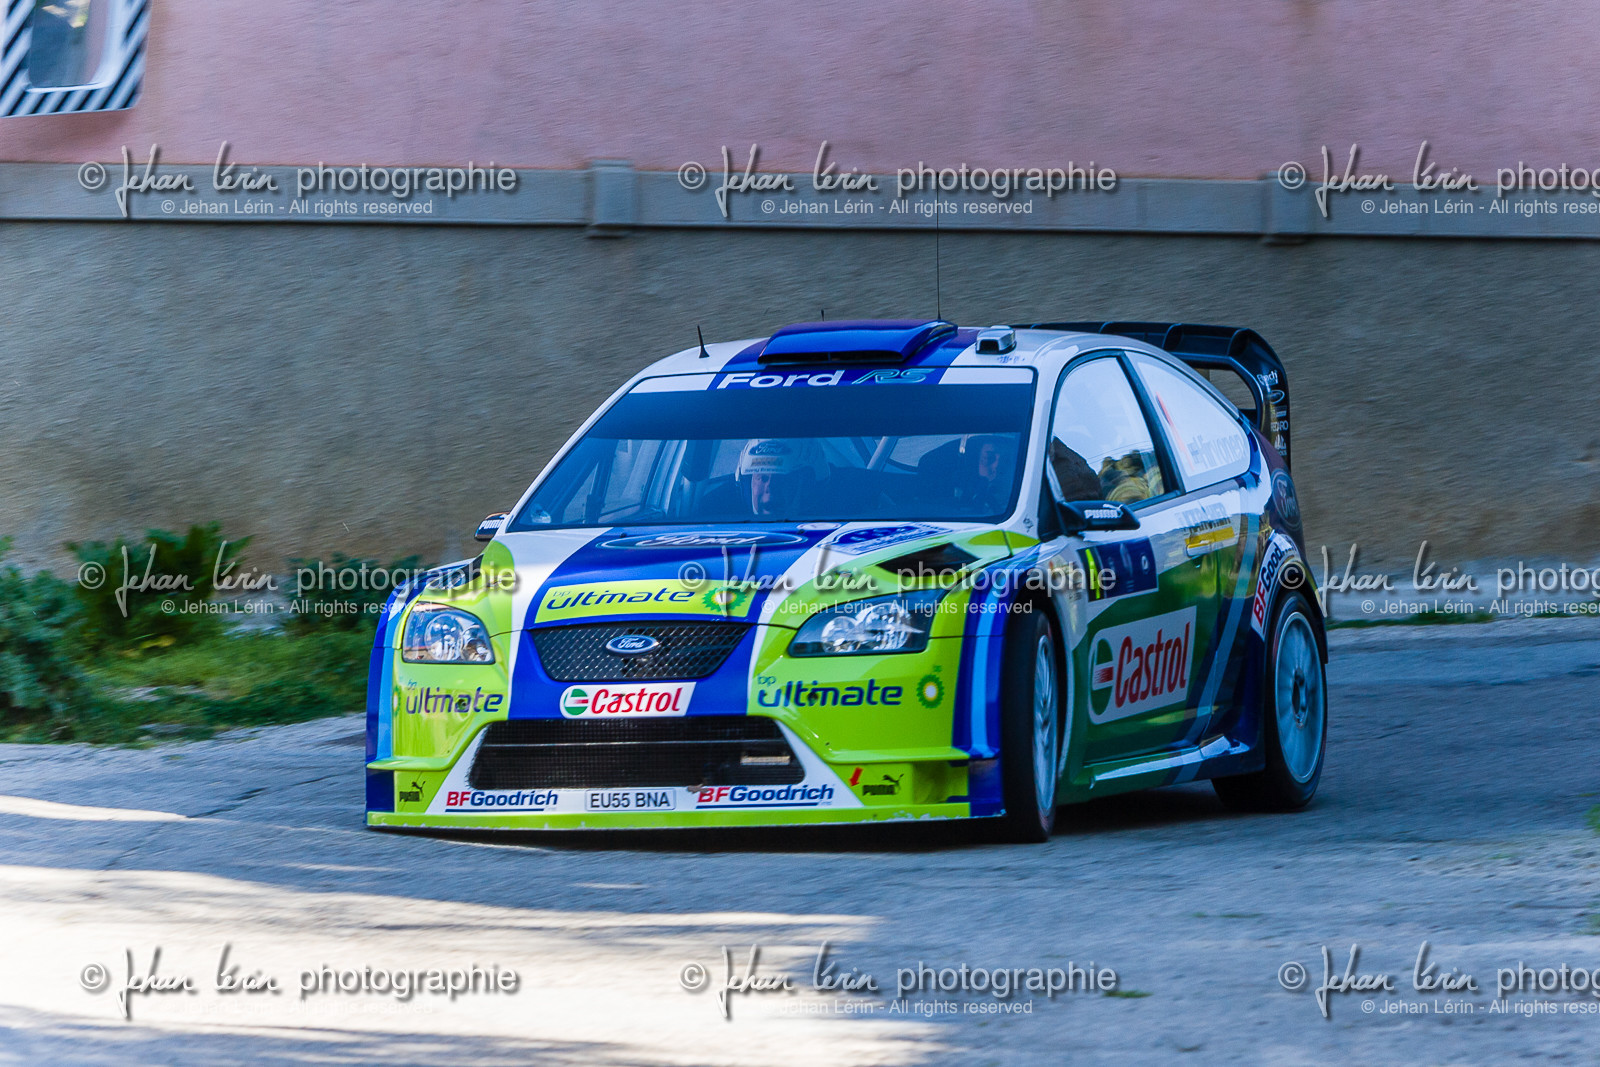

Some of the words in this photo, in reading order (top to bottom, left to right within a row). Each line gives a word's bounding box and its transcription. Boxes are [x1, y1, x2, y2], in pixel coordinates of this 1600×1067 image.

[717, 370, 845, 389] Ford
[546, 588, 696, 611] ultimate
[617, 637, 647, 650] Ford
[1115, 622, 1191, 708] Castrol
[405, 686, 504, 715] ultimate
[591, 686, 685, 714] Castrol
[757, 679, 904, 708] ultimate
[446, 789, 559, 807] BFGoodrich
[590, 791, 630, 808] EU55
[637, 791, 671, 808] BNA
[697, 784, 834, 803] BFGoodrich
